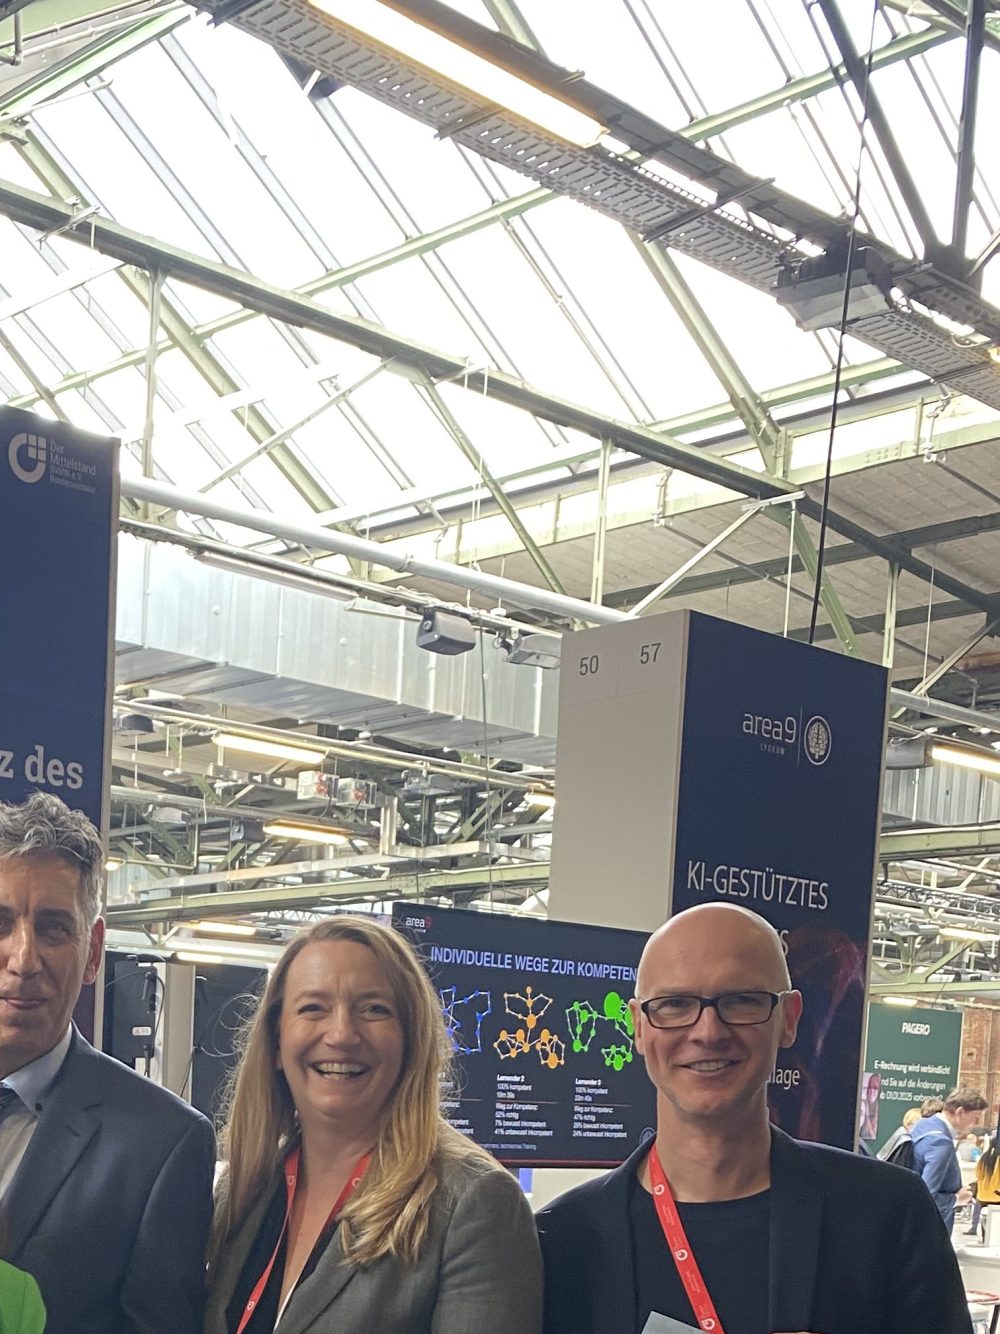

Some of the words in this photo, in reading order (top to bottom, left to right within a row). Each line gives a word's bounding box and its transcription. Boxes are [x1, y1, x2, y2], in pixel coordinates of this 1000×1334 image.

[50, 440, 64, 454] Der
[50, 453, 96, 475] Mittelstand
[640, 642, 661, 665] 57
[579, 655, 600, 676] 50
[742, 713, 797, 744] area9
[24, 745, 83, 789] des
[687, 860, 829, 910] KI-GESTÜTZTES
[430, 946, 512, 969] INDIVIDUELLE
[514, 956, 550, 973] WEGE
[551, 958, 575, 976] ZUR
[577, 961, 637, 982] KOMPETEN
[902, 1022, 930, 1036] PAGERO
[874, 1060, 907, 1073] E-Rechnung
